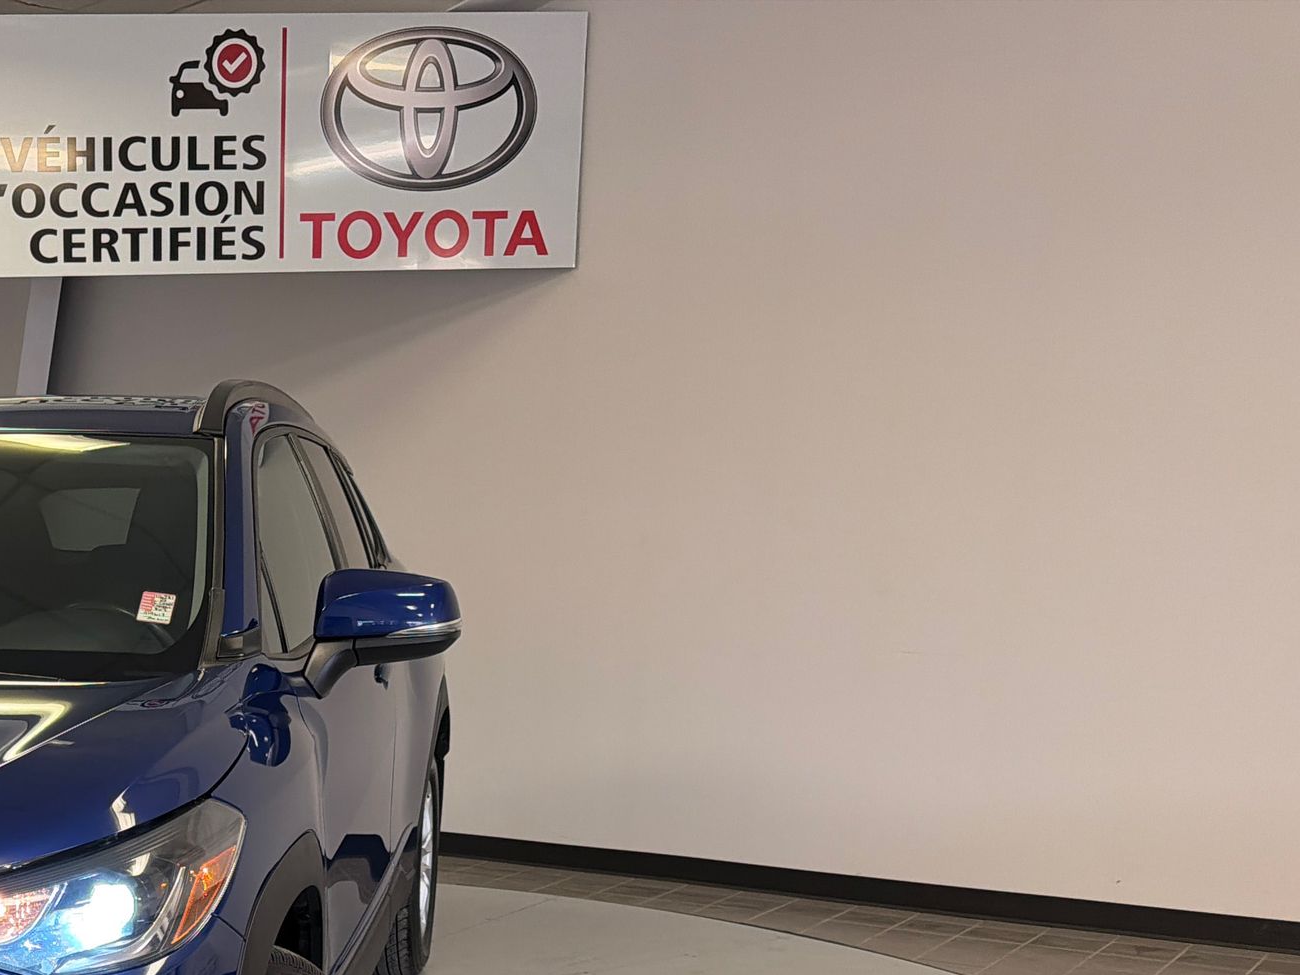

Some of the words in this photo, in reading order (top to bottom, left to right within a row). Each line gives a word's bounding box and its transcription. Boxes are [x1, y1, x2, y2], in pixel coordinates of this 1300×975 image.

[0, 126, 267, 173] VÉHICULES
[29, 215, 266, 263] CERTIFIÉS
[300, 210, 549, 260] TOYOTA
